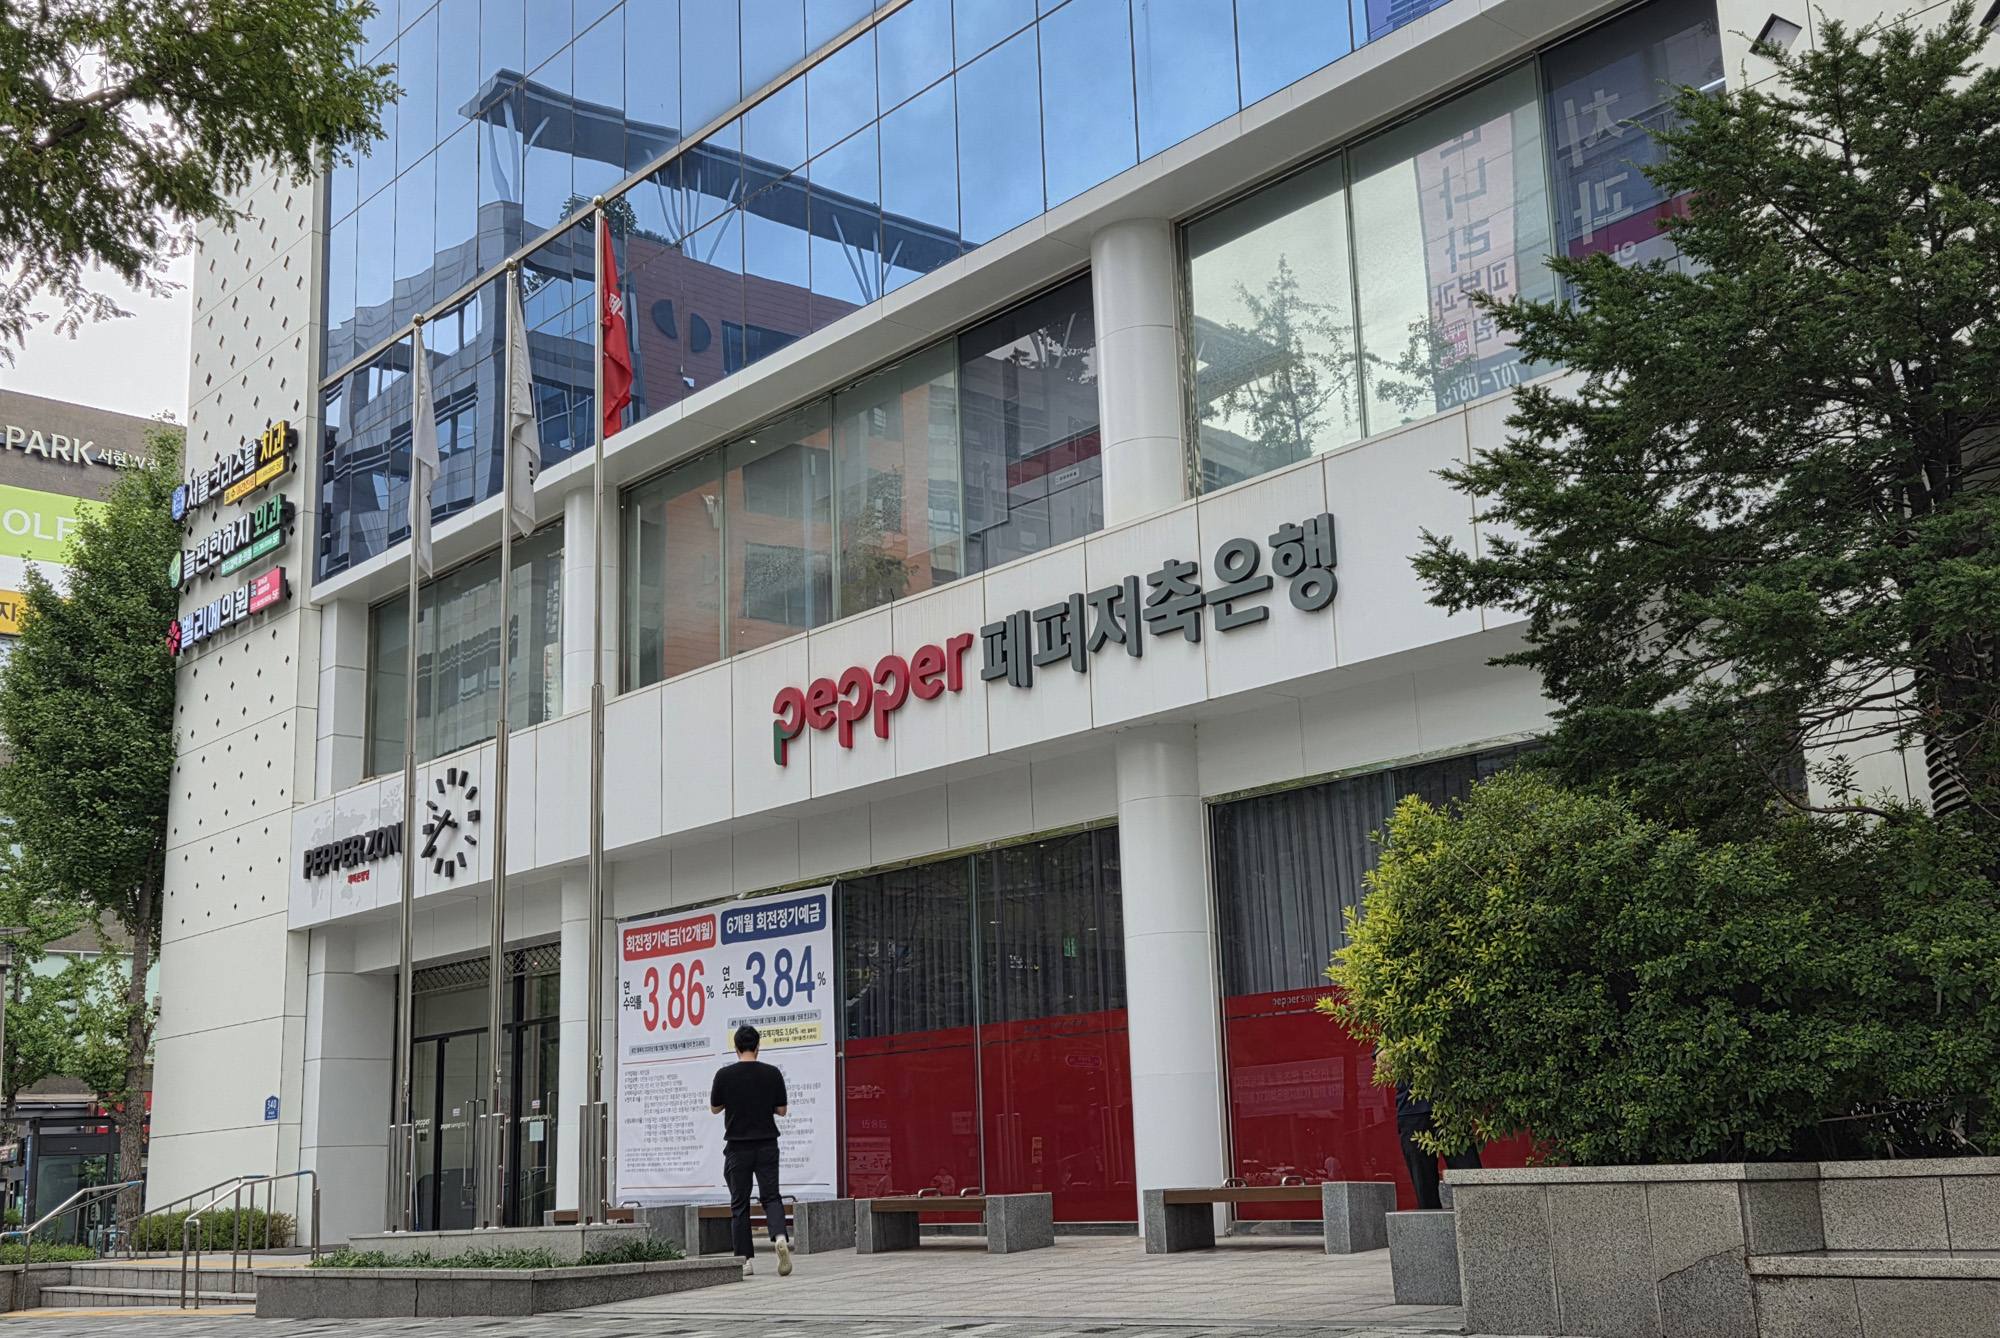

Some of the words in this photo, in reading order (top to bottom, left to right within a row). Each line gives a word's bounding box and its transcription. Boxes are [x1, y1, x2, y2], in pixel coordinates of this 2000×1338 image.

[5, 425, 94, 466] PARK
[187, 440, 257, 509] 서울크리스탈
[260, 420, 286, 462] 치과
[183, 512, 252, 580] 늘편한하지
[253, 494, 283, 538] 외과
[181, 584, 249, 649] 벨리에의원
[773, 632, 974, 767] pepper
[980, 512, 1338, 688] 페퍼저축은행
[365, 820, 404, 862] ZON
[726, 913, 754, 934] 6개월
[756, 903, 821, 931] 회전정기예금
[625, 921, 714, 952] 회전정기예금(12개월)
[623, 980, 631, 995] 연
[722, 965, 731, 981] 연
[623, 995, 642, 1011] 수익률
[721, 980, 745, 999] 수익률
[1272, 994, 1300, 1008] pepper
